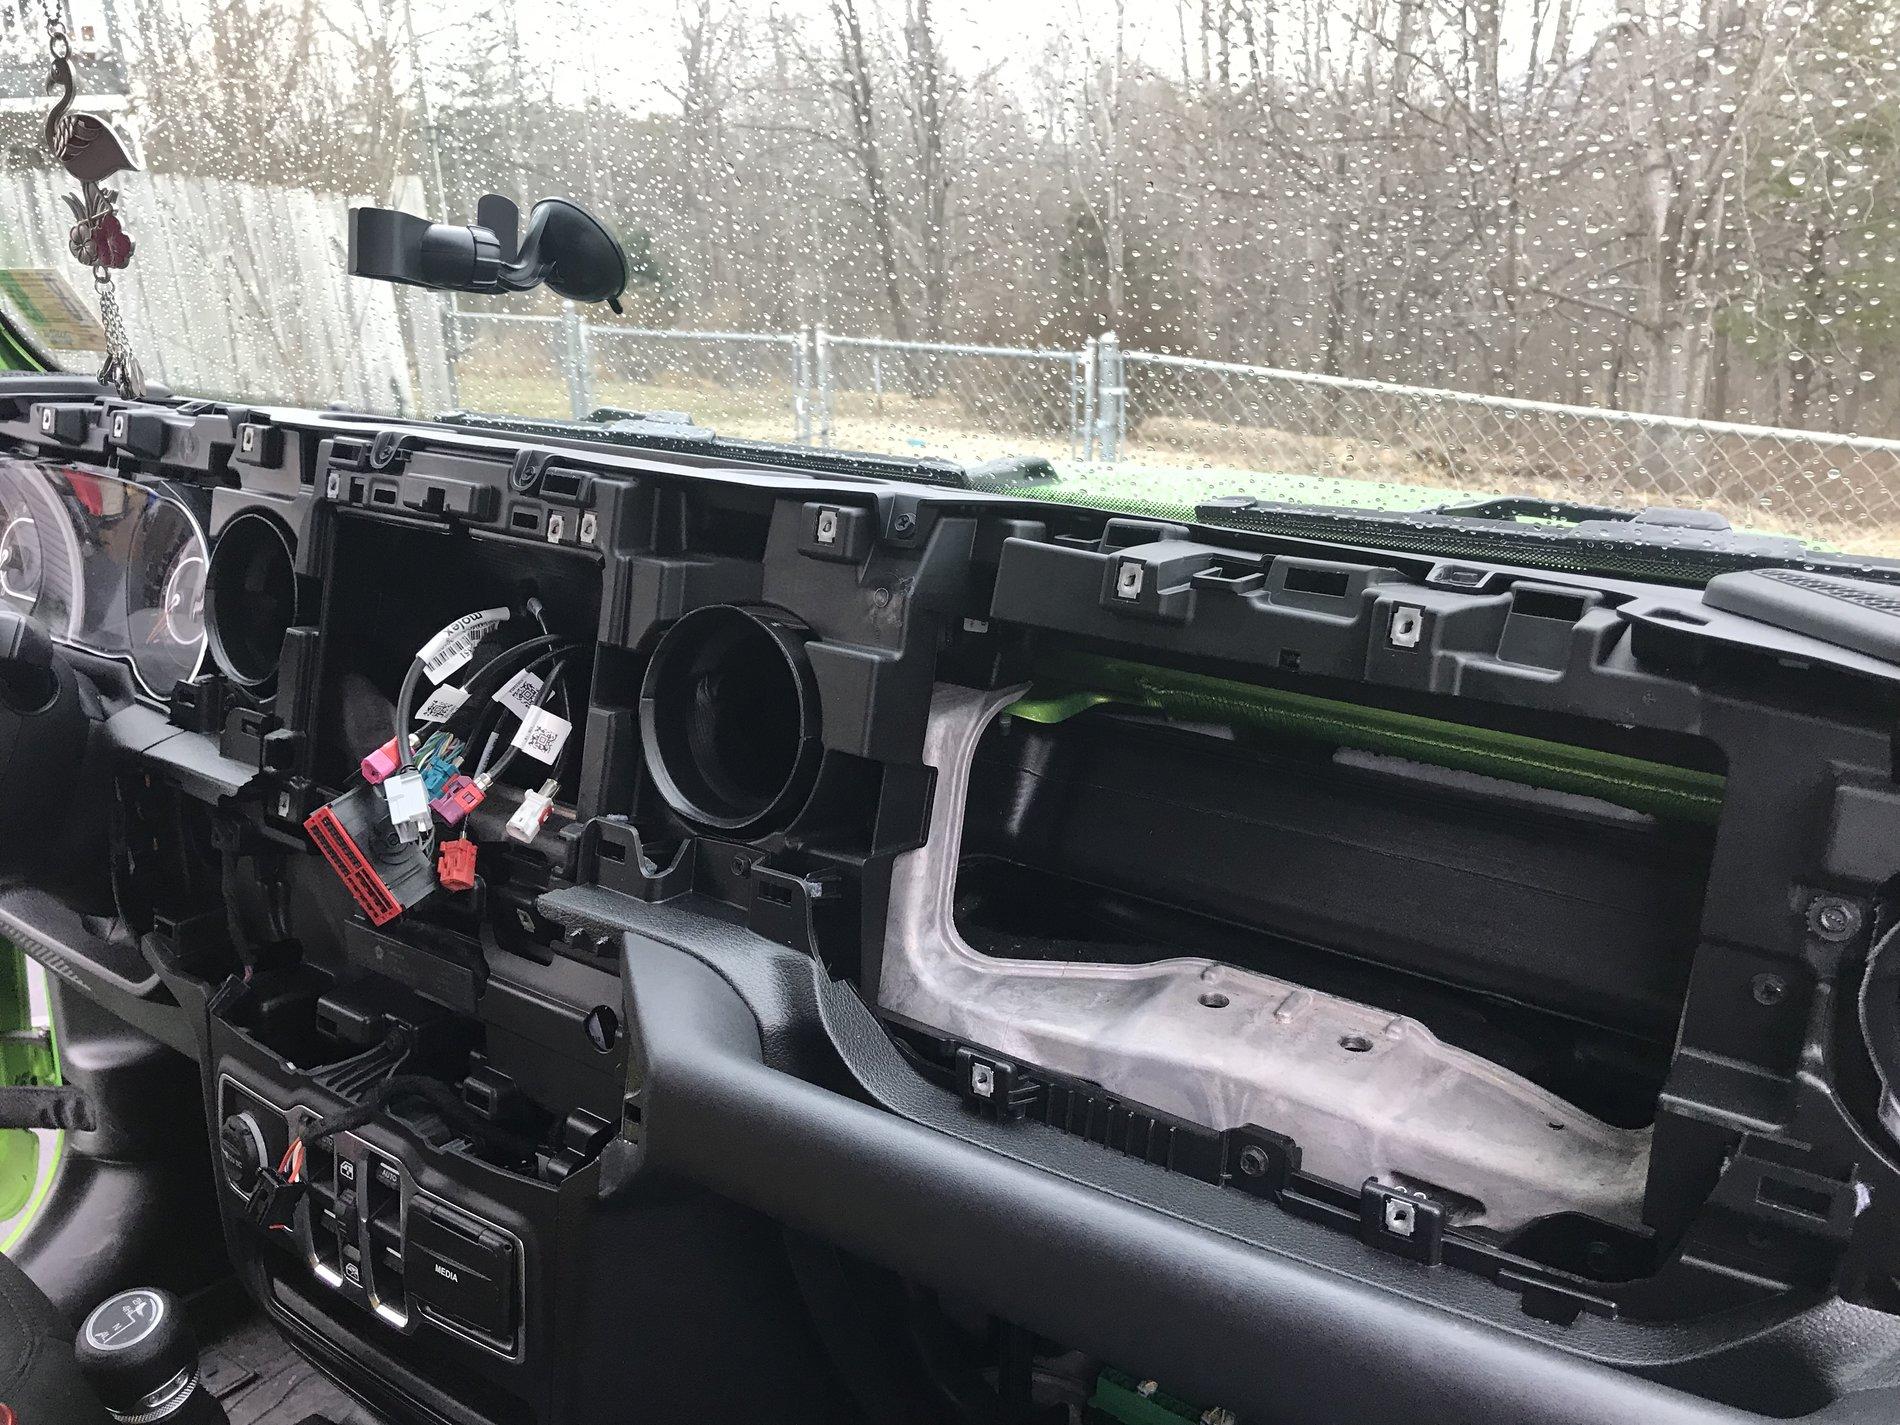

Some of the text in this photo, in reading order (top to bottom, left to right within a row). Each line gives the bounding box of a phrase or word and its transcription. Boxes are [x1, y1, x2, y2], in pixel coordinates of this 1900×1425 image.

[443, 612, 482, 636] molex
[382, 1170, 397, 1182] AUTO
[435, 1264, 458, 1282] MEDIA
[112, 1322, 122, 1331] N
